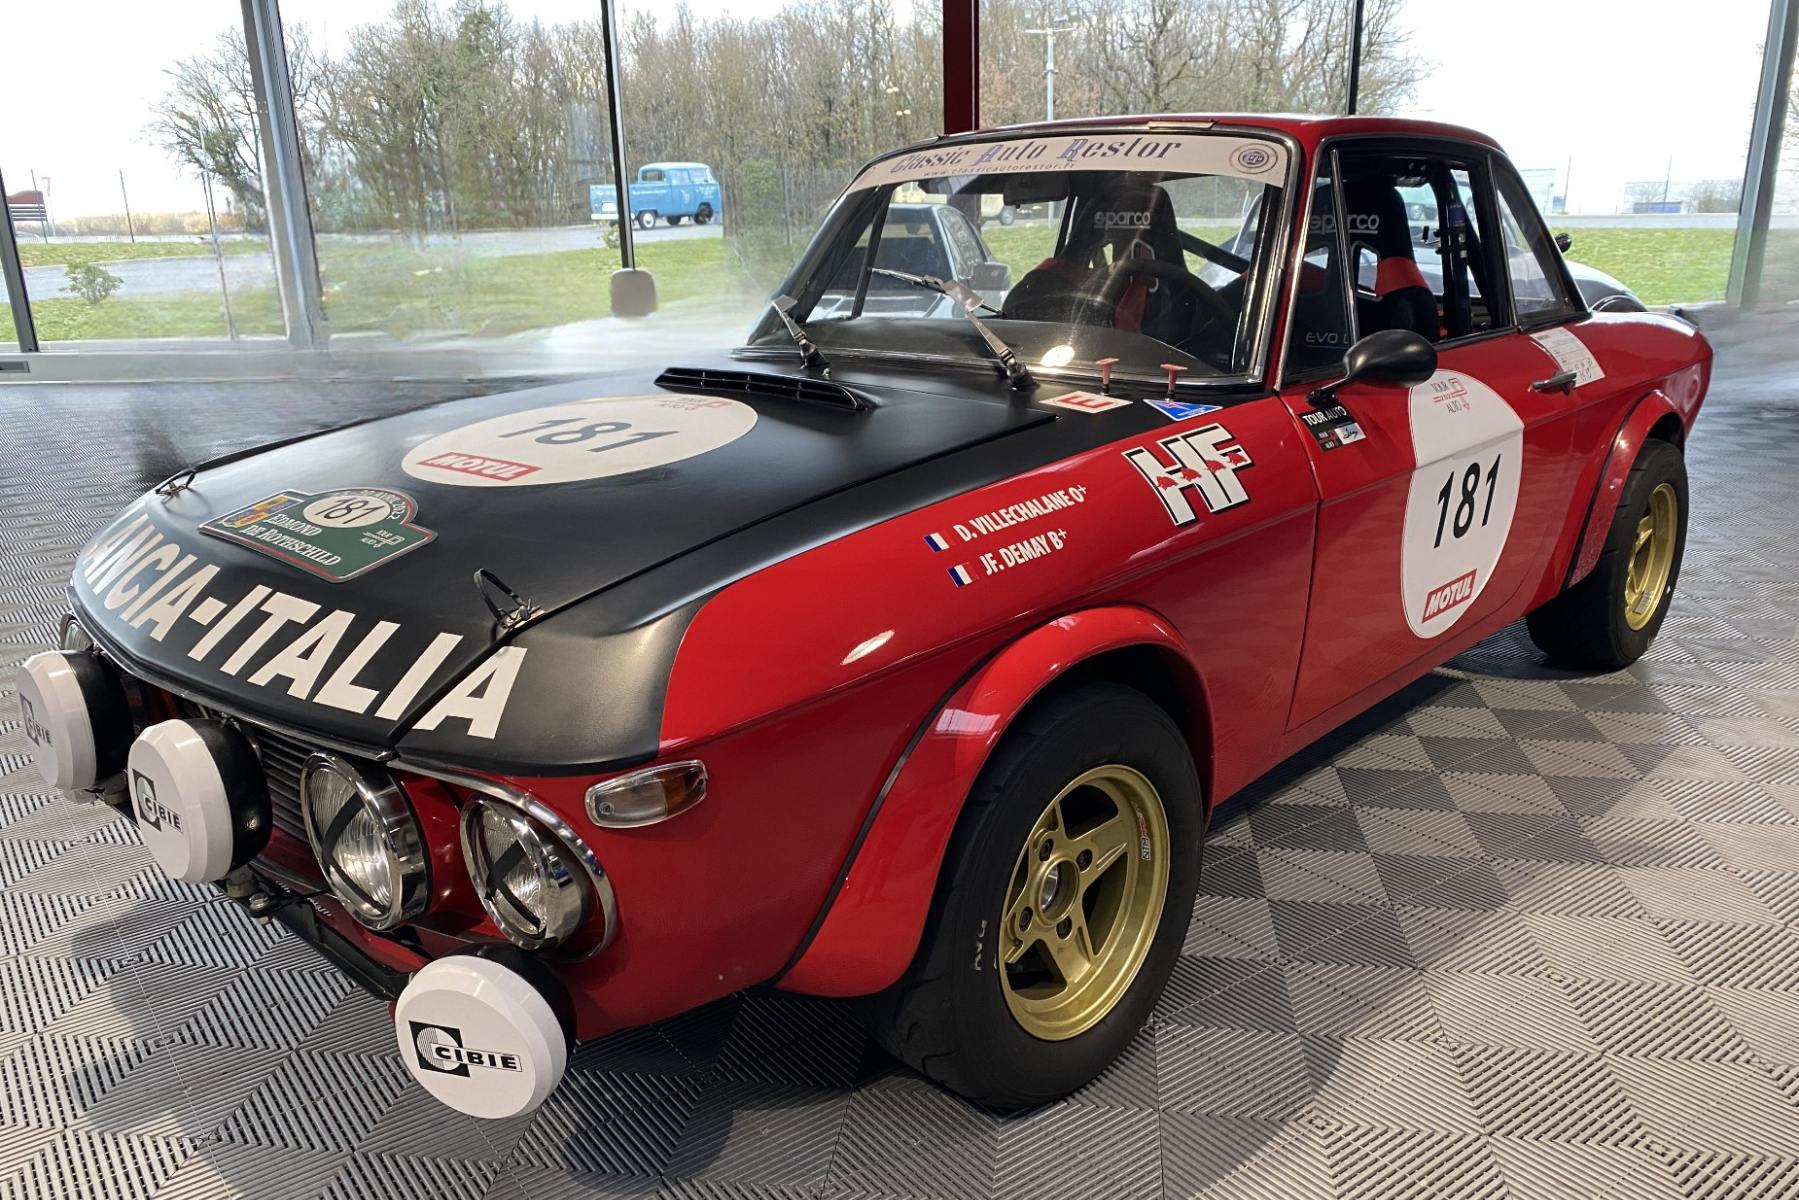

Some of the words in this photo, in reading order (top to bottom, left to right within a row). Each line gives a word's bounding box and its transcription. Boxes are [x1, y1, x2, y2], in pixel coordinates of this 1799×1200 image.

[890, 147, 971, 173] Classic
[969, 141, 1047, 166] Auto
[1057, 137, 1182, 161] Restor
[1309, 213, 1380, 235] sprco
[1305, 331, 1339, 344] EVO
[1302, 411, 1328, 426] TOUR
[1326, 406, 1347, 421] AUTO
[498, 417, 681, 453] 181
[432, 453, 524, 480] MOTUL
[1121, 422, 1254, 527] HF
[314, 497, 385, 525] 181
[953, 524, 978, 542] D.
[968, 489, 1076, 535] VILLECHALANE
[1433, 454, 1502, 548] 181
[263, 513, 323, 537] EDMOND
[256, 528, 342, 566] ROTHSCHILD
[980, 553, 1005, 576] JF.
[999, 534, 1052, 568] DEMAY
[1425, 574, 1473, 618] MOTUL
[82, 513, 528, 739] ANCIA-ITALIA
[434, 1045, 518, 1070] CIBIE
